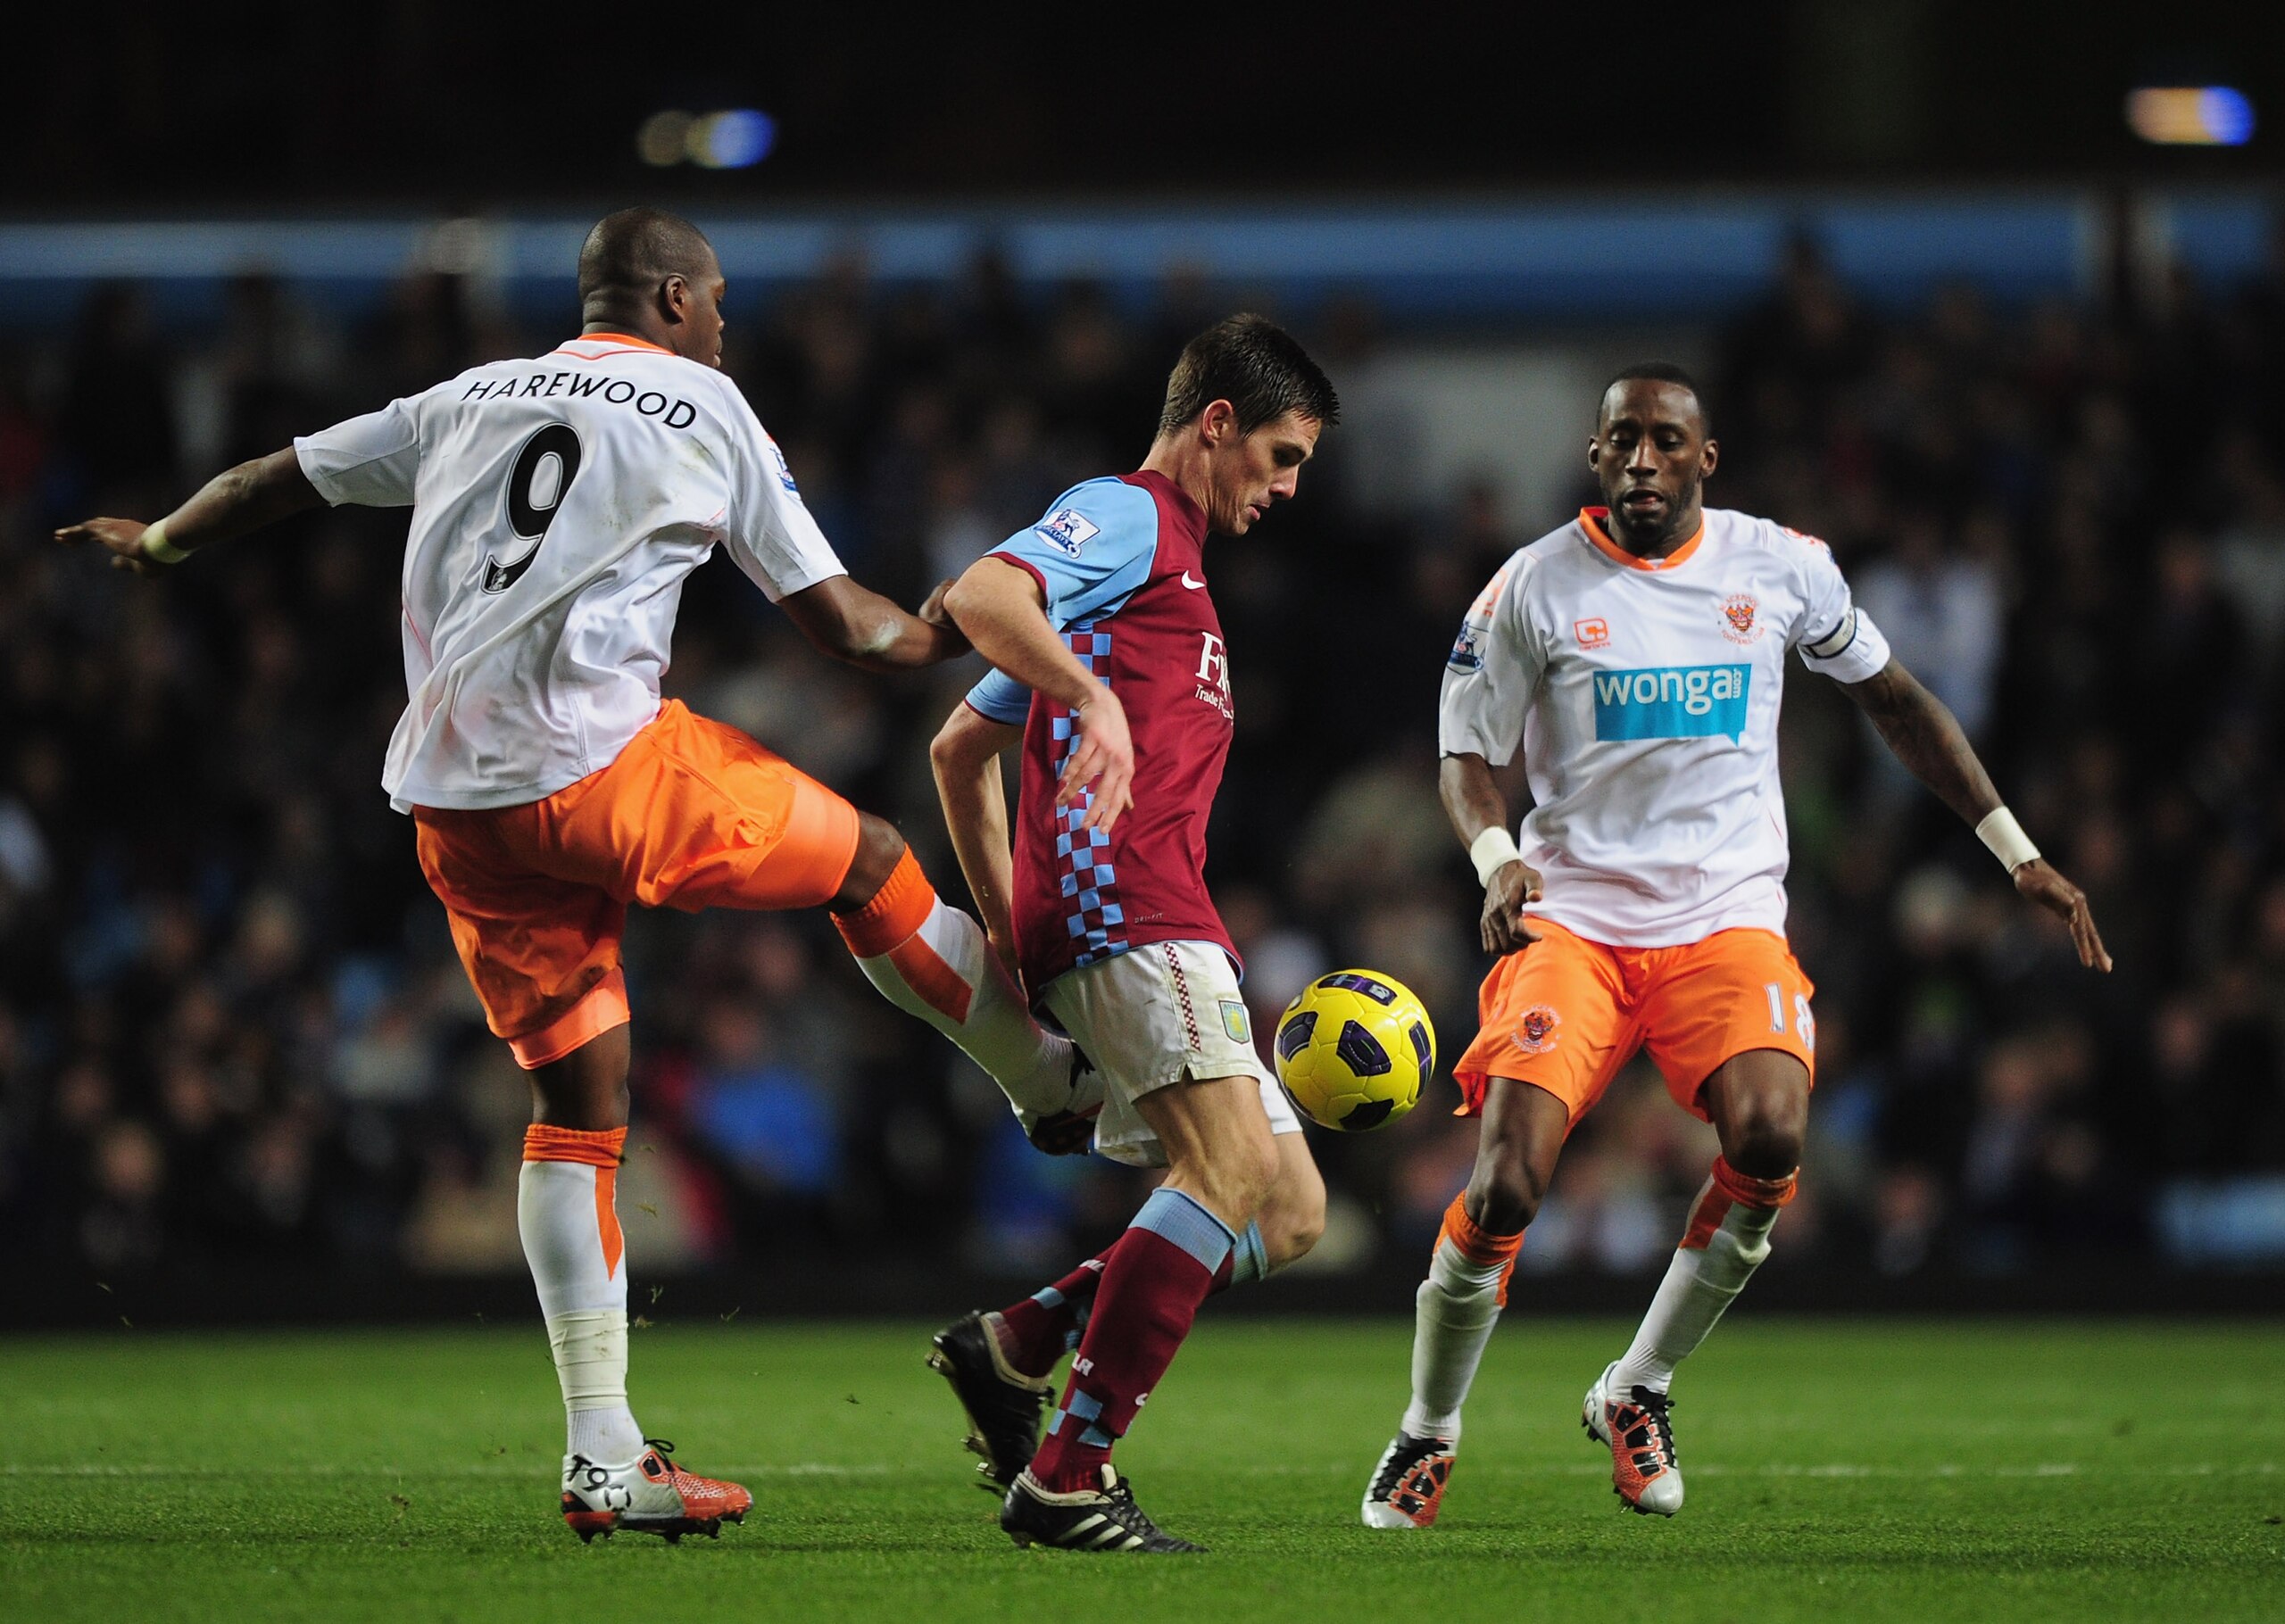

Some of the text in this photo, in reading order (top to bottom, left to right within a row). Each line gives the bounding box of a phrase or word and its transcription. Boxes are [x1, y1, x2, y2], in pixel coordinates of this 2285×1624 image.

[461, 372, 697, 430] HAREWOOD
[480, 420, 584, 595] 9
[1195, 684, 1218, 708] Trade
[1597, 668, 1732, 716] wonga
[1764, 982, 1816, 1052] 18
